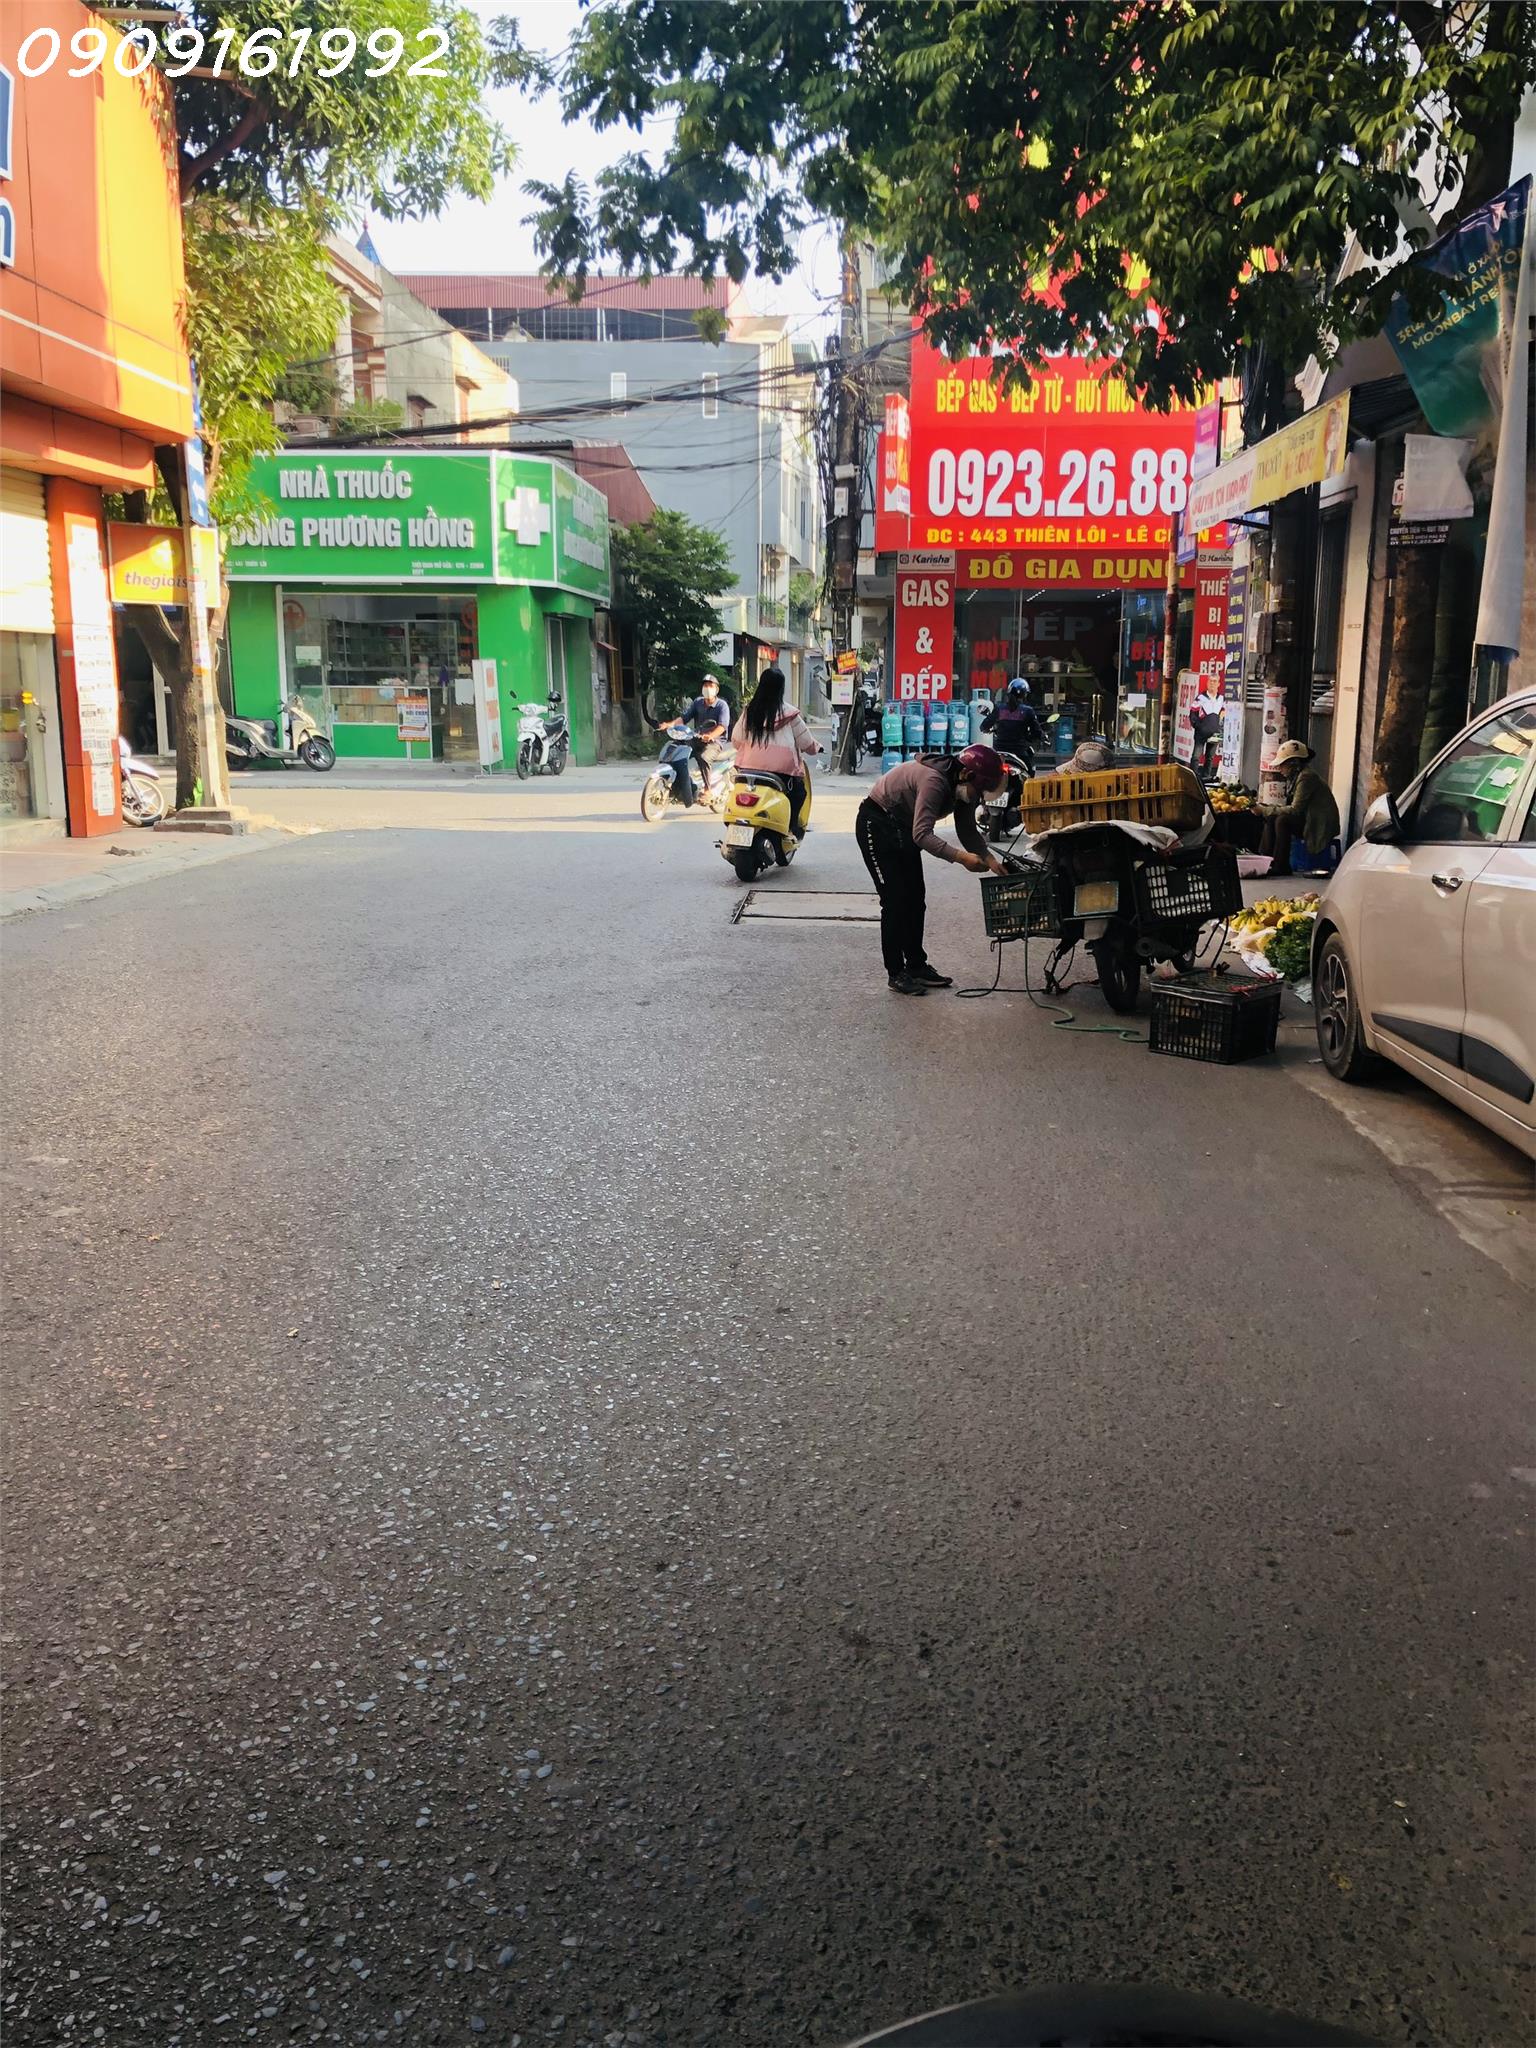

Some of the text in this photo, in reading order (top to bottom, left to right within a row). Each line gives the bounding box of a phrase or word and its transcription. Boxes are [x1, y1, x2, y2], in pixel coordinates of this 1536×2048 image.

[1411, 301, 1477, 350] MOONBAY
[936, 368, 965, 413] BẾP
[969, 379, 997, 413] GAS
[1076, 372, 1101, 413] HÚT
[279, 459, 412, 499] NHÀ THUỐC
[928, 448, 1195, 517] 0923.26.88
[302, 514, 401, 547] PHƯƠNG
[408, 505, 474, 548] HỒNG
[926, 528, 952, 543] ĐC
[970, 529, 1007, 543] 443
[1014, 525, 1070, 543] THIÊN
[1076, 525, 1106, 543] LÔI
[1126, 525, 1148, 543] LÊ
[1154, 527, 1209, 544] CN
[911, 554, 950, 564] Karisha
[968, 552, 1014, 579] ĐỒ
[1025, 558, 1081, 579] GIA
[902, 579, 950, 607] GAS
[1208, 607, 1221, 627] BỊ
[915, 627, 933, 654] &
[1200, 630, 1226, 650] NHÀ
[1200, 655, 1224, 677] BẾP
[901, 665, 947, 700] BẾP
